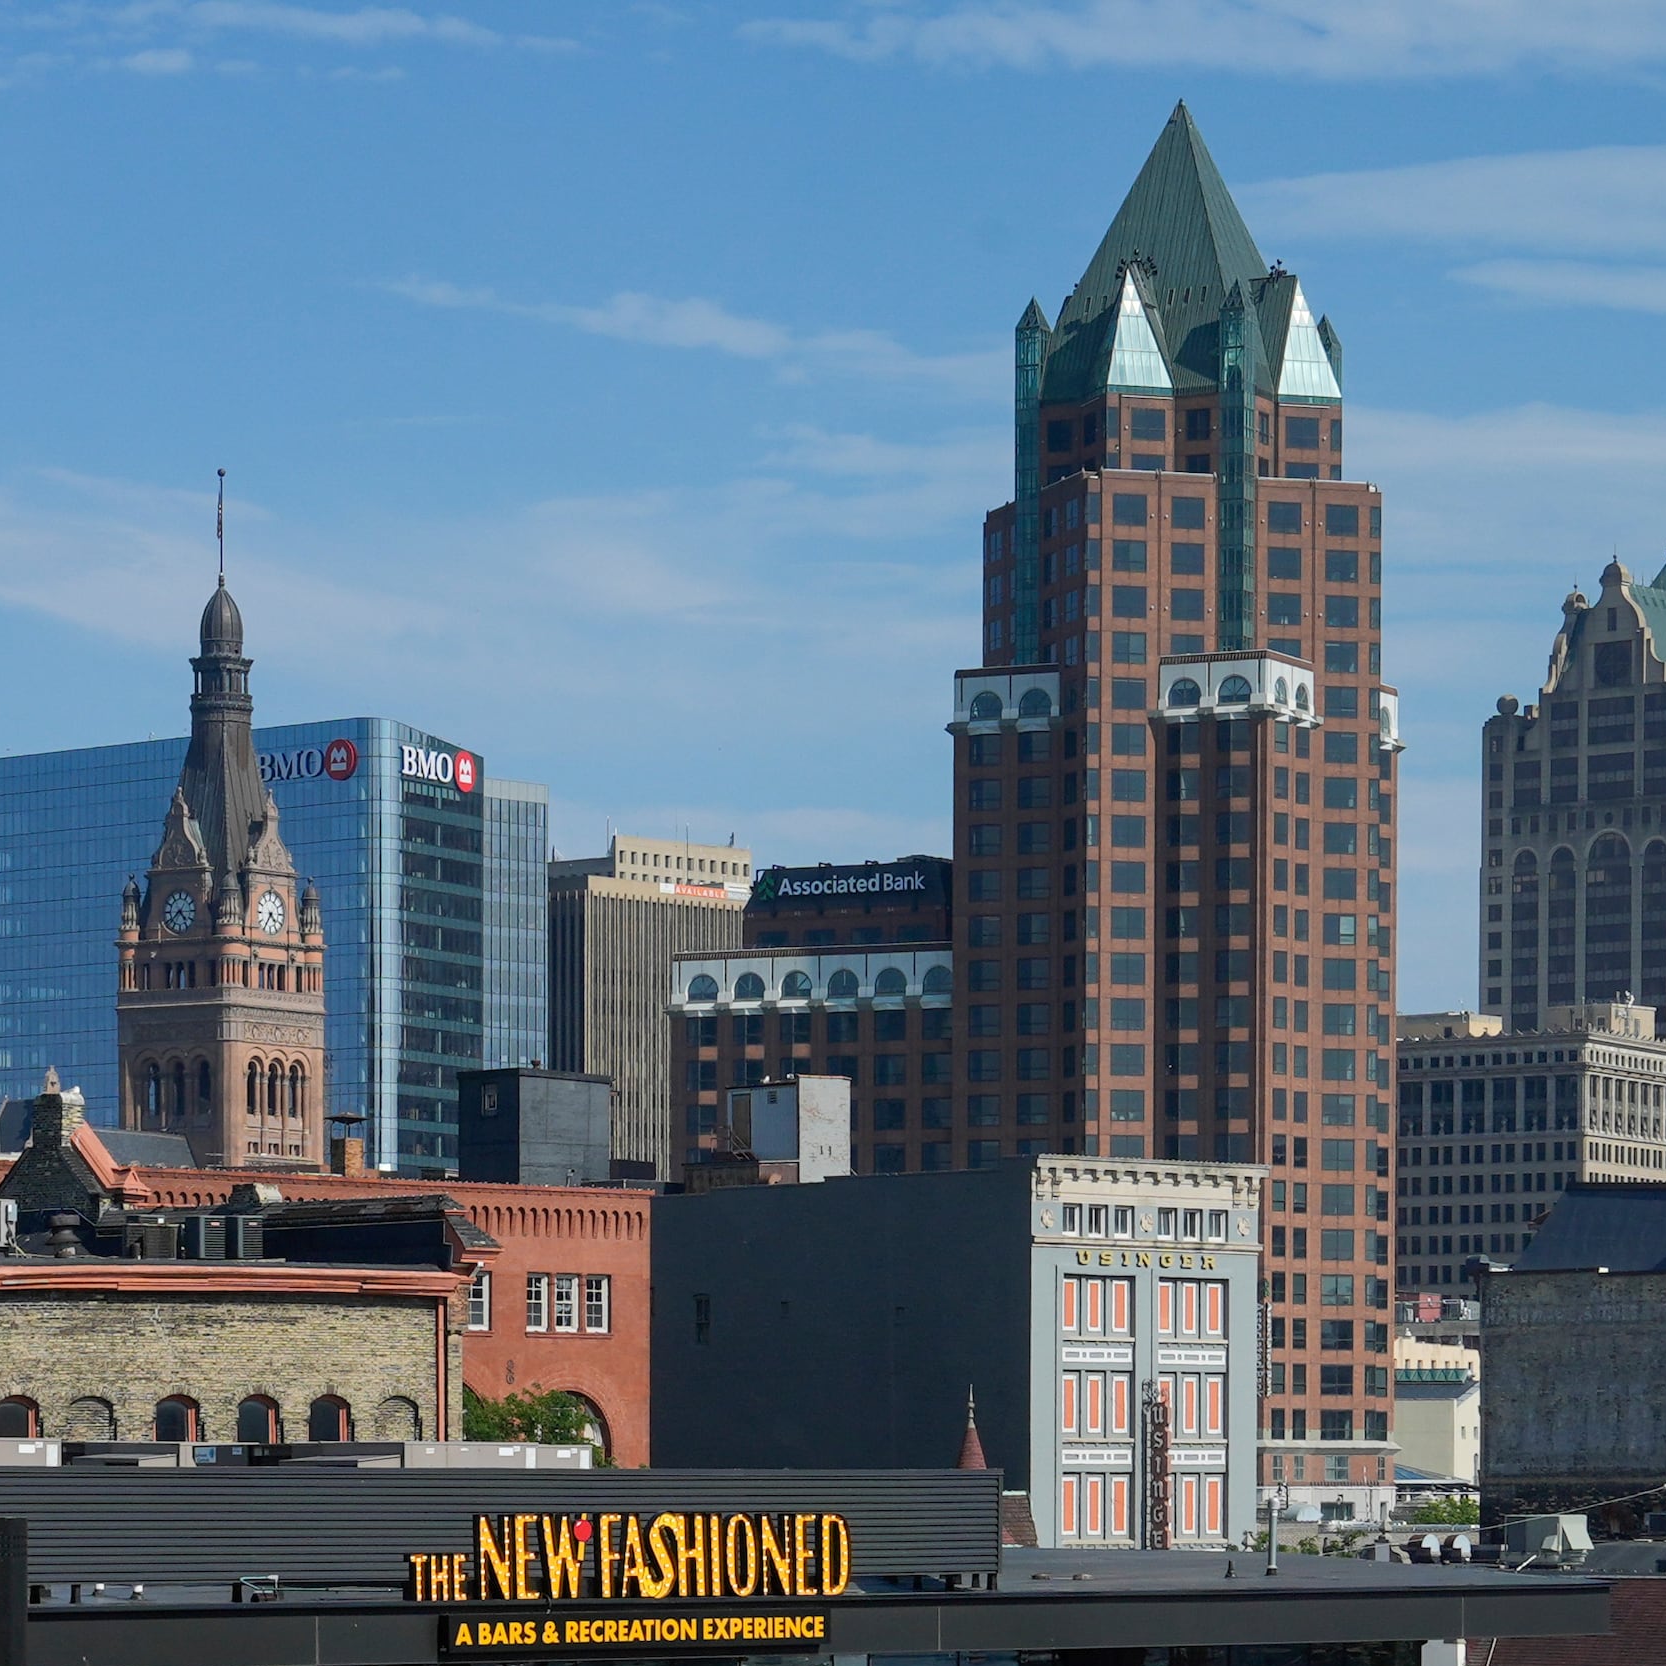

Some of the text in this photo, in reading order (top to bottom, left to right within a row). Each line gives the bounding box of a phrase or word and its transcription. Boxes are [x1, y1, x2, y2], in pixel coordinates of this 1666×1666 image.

[259, 749, 324, 782] BMO
[401, 746, 453, 783] BMO
[675, 884, 726, 898] AVAILABLE
[778, 871, 925, 896] Associated Bank
[1076, 1250, 1217, 1270] USINGER
[410, 1511, 852, 1601] THE NEW FASHIONED
[455, 1616, 824, 1646] A BARS & RECREATION EXPERIENCE
